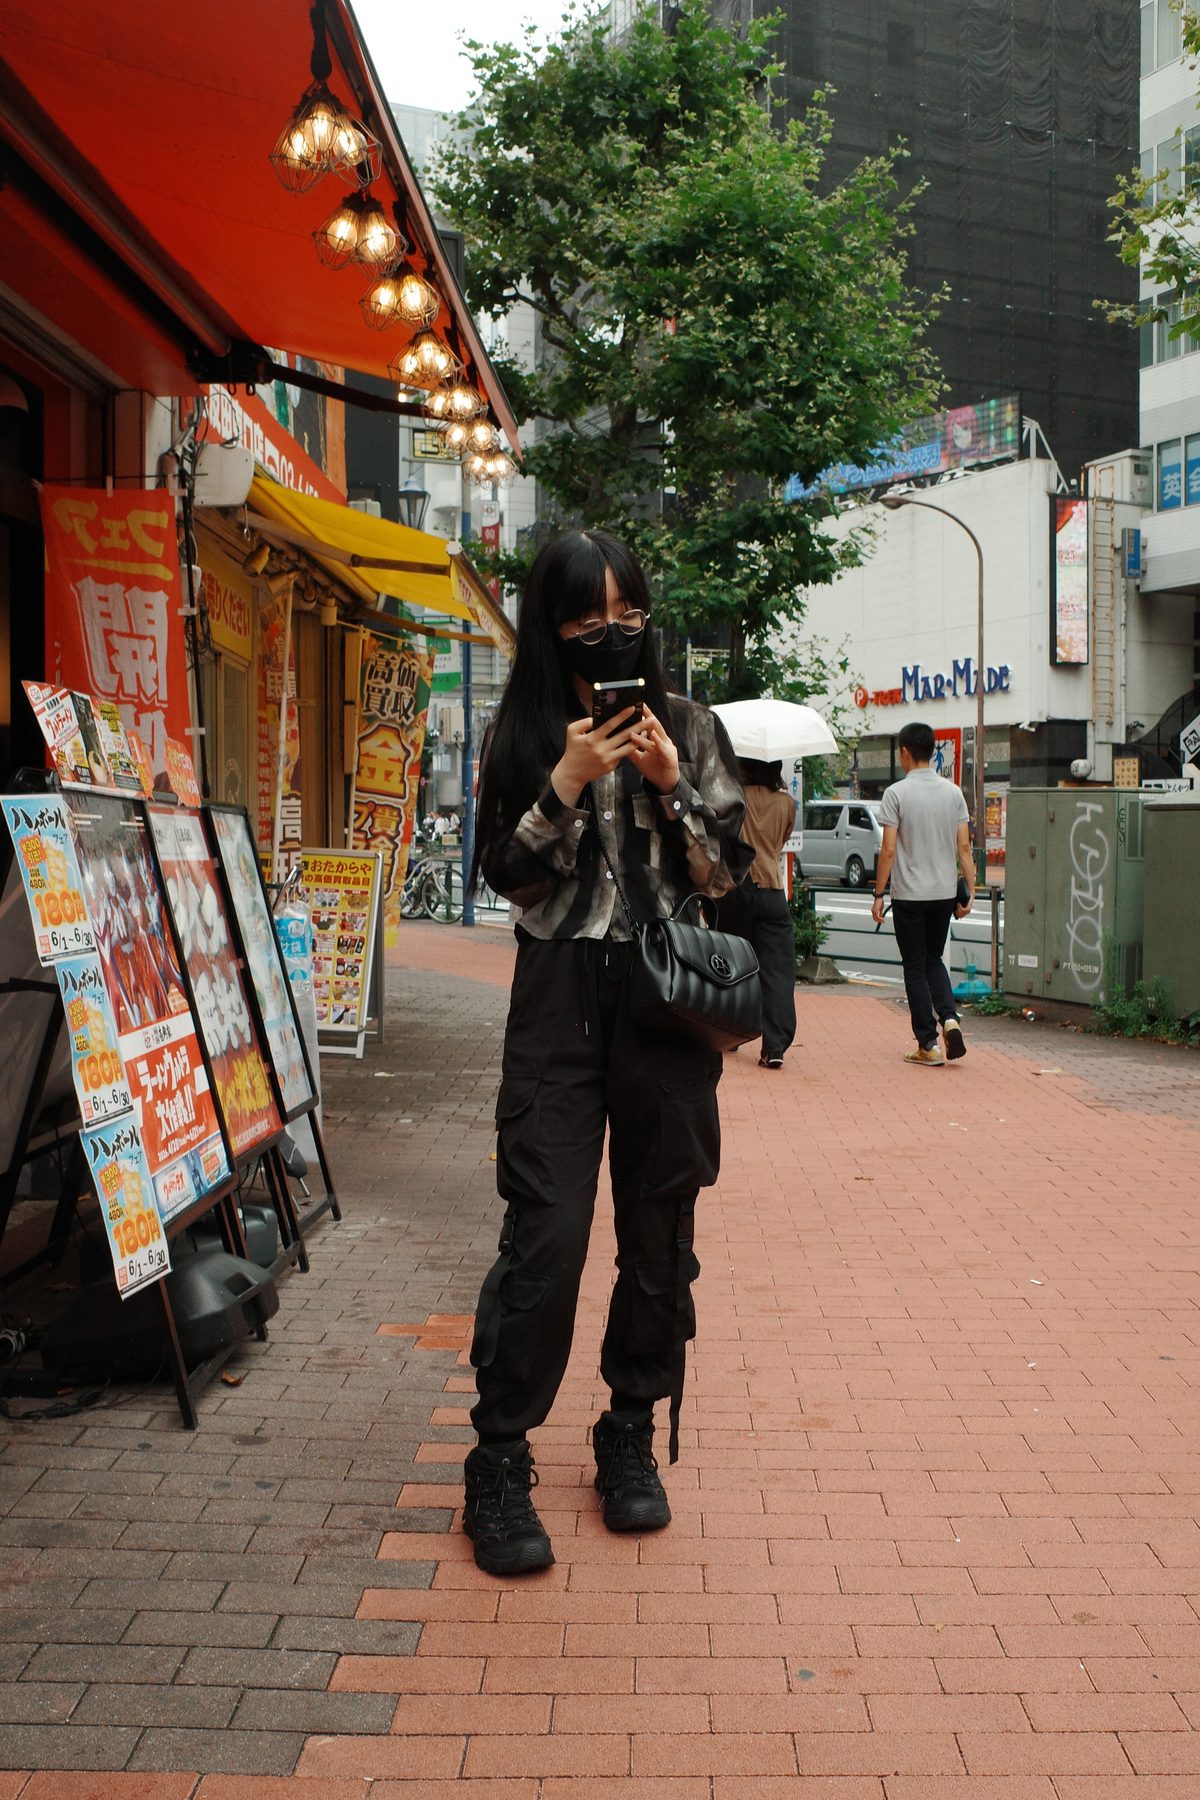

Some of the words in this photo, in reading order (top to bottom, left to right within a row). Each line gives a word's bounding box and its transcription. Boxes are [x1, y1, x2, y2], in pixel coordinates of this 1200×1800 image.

[367, 652, 417, 691] 高価
[362, 685, 414, 720] 買取
[11, 808, 66, 834] ハイボール
[311, 860, 371, 875] おたからや
[35, 891, 87, 928] 180円
[90, 1124, 140, 1162] ハイボール
[113, 1210, 161, 1258] 180円
